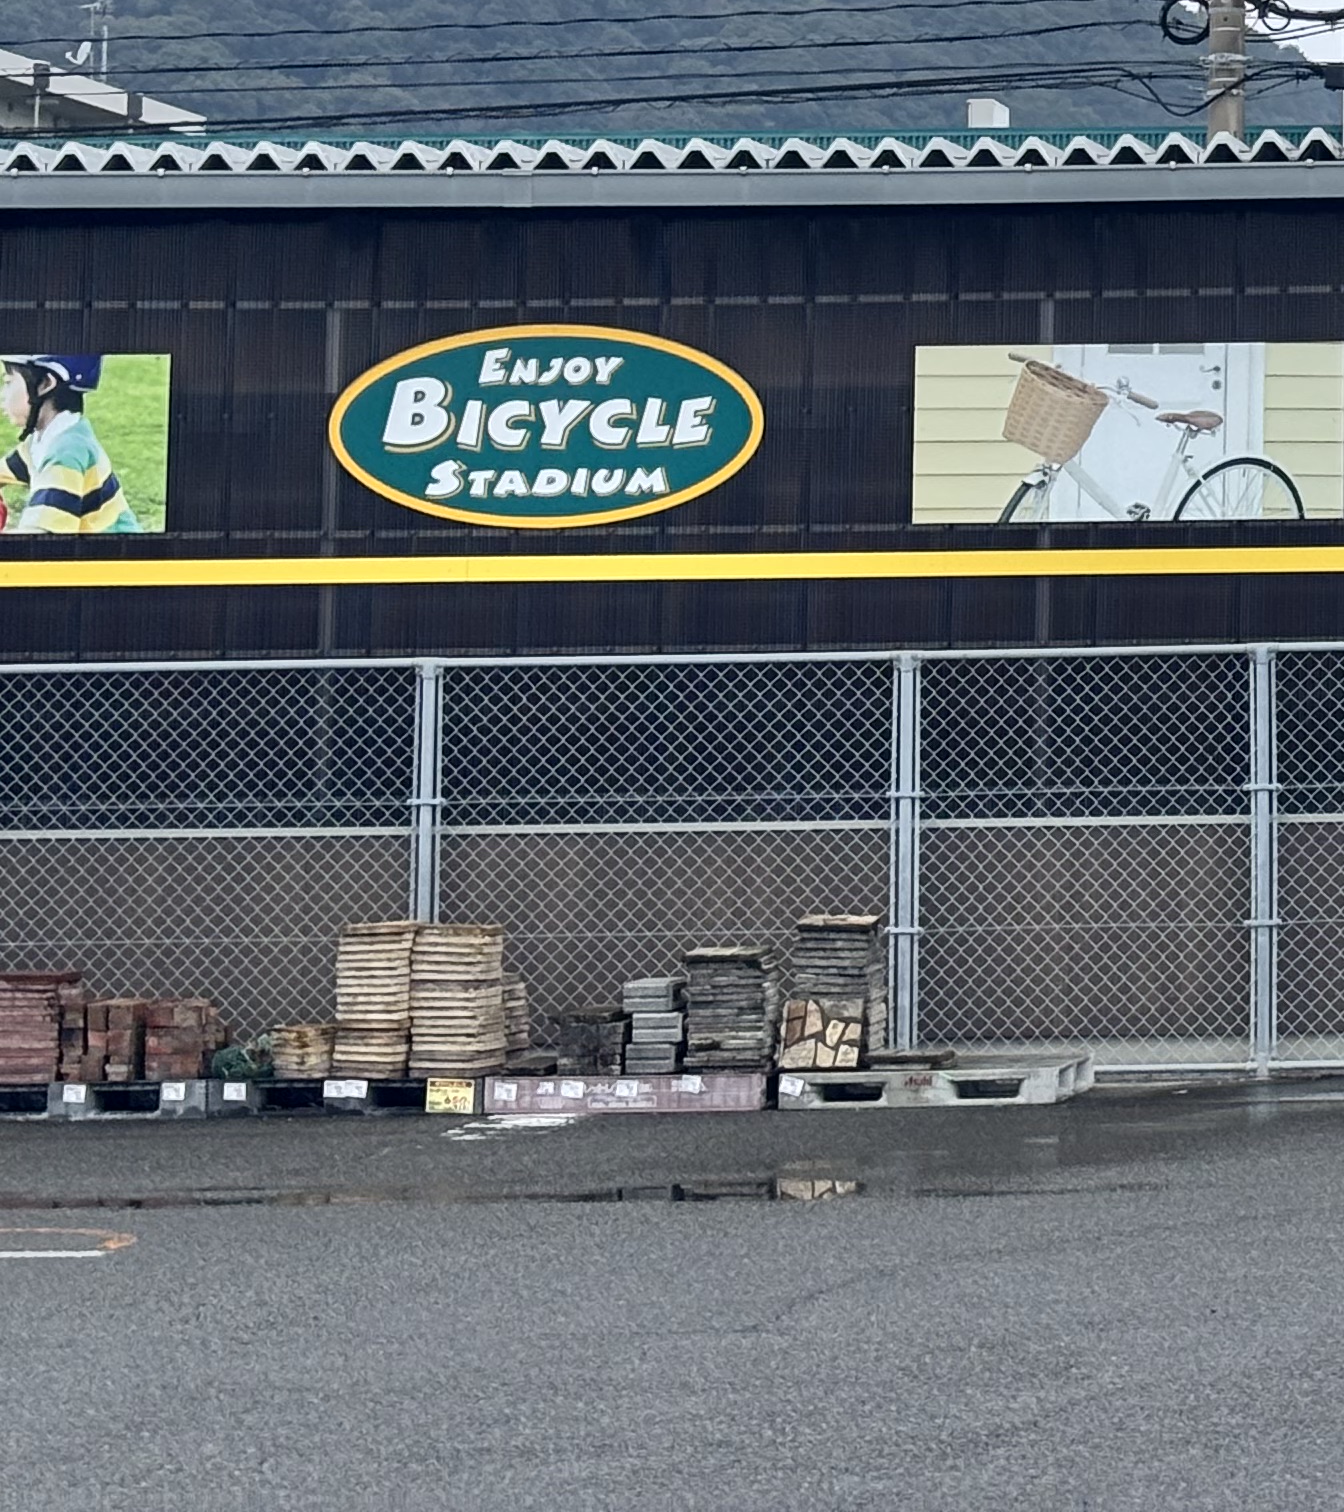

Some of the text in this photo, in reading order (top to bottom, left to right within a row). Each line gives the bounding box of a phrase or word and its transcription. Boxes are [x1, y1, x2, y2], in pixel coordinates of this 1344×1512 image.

[478, 347, 624, 385] ENJOY
[381, 376, 717, 450] BICYCLE
[425, 459, 668, 498] STADIUM
